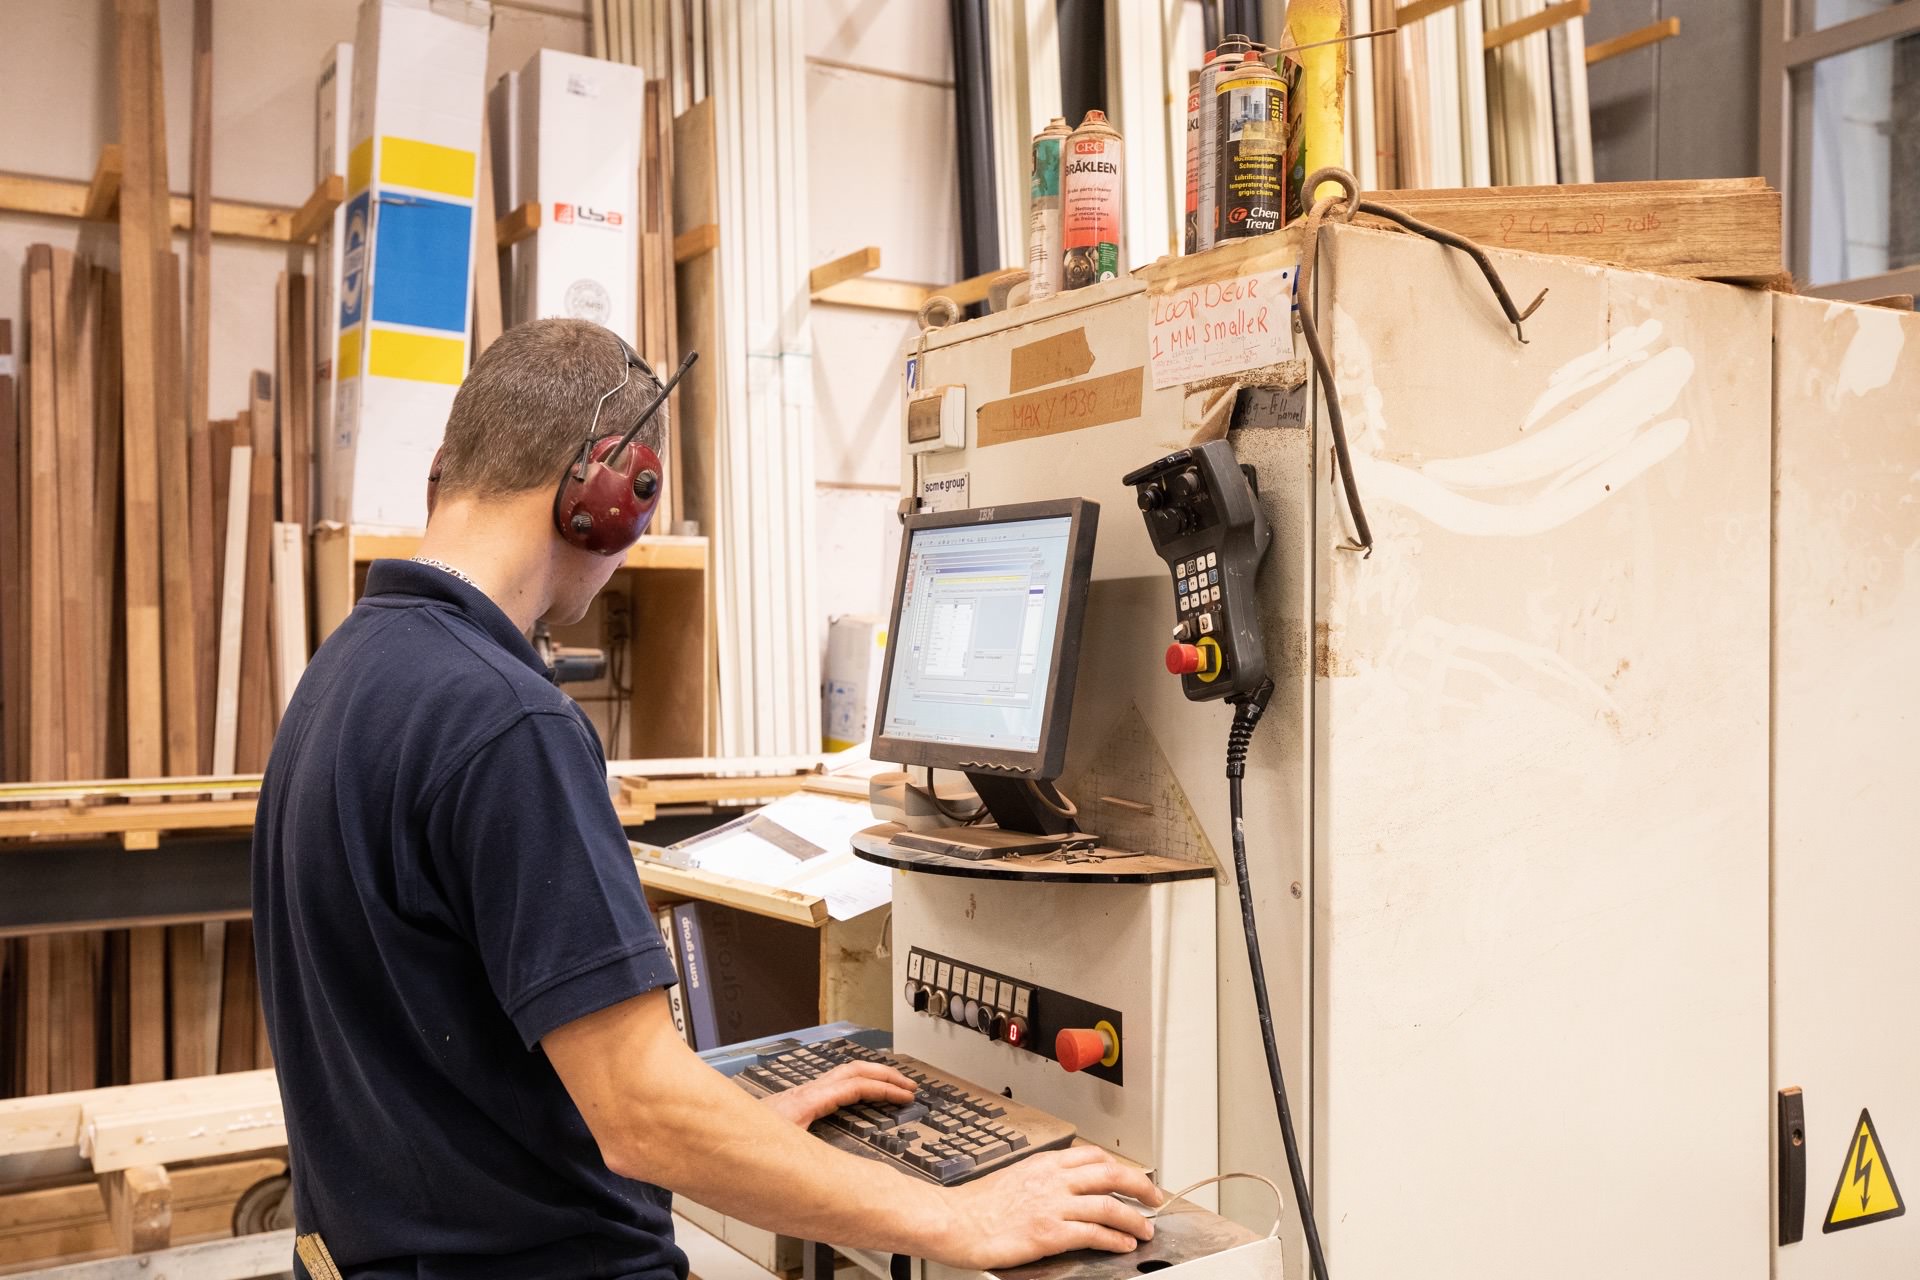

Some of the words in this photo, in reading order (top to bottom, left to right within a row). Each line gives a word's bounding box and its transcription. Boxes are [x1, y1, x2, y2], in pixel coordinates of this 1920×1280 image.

[1075, 142, 1104, 153] CRC
[1250, 207, 1279, 220] Chem
[1245, 218, 1275, 230] Trend
[1012, 403, 1041, 429] MAX
[945, 477, 965, 492] group
[978, 508, 996, 521] IBM
[682, 916, 695, 953] group
[689, 962, 699, 989] scm
